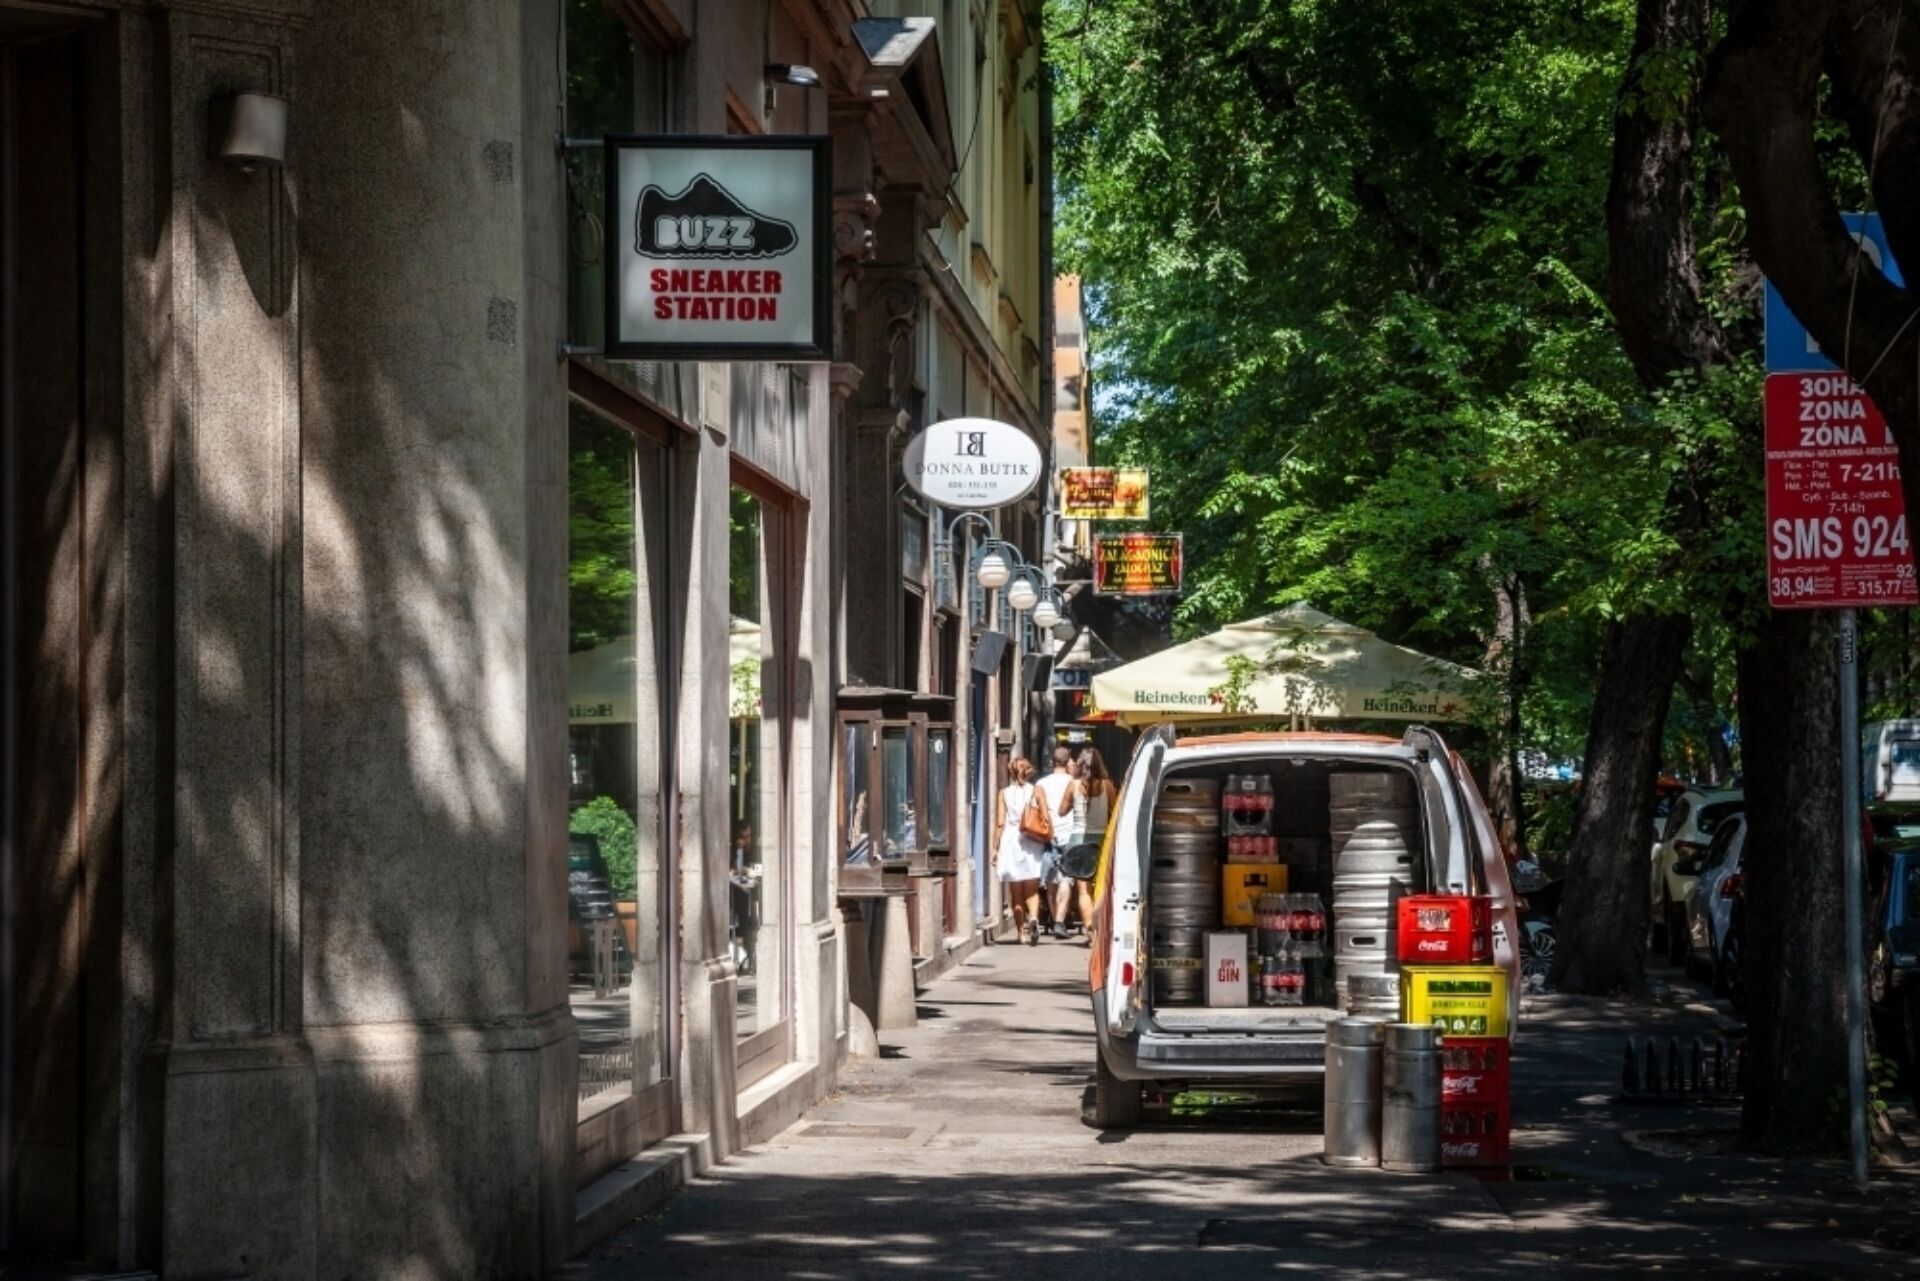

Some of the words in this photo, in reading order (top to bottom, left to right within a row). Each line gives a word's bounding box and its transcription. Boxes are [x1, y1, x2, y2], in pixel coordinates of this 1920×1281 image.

[655, 215, 755, 250] BUZZ
[650, 268, 783, 294] SNEAKER
[654, 296, 777, 321] STATION
[1799, 399, 1867, 422] ZONA
[1800, 422, 1867, 447] ZÓNA
[915, 463, 974, 475] DONNA
[979, 463, 1029, 475] BUTIK
[1839, 462, 1901, 483] 7-21h
[1828, 502, 1865, 514] 7-14h
[1773, 516, 1843, 560] SMS
[1853, 514, 1909, 558] 924
[1772, 576, 1815, 599] 38,94
[1858, 580, 1901, 597] 315,77
[1134, 690, 1207, 706] Heineken
[1363, 699, 1438, 714] Heineken
[1219, 967, 1239, 982] GIN
